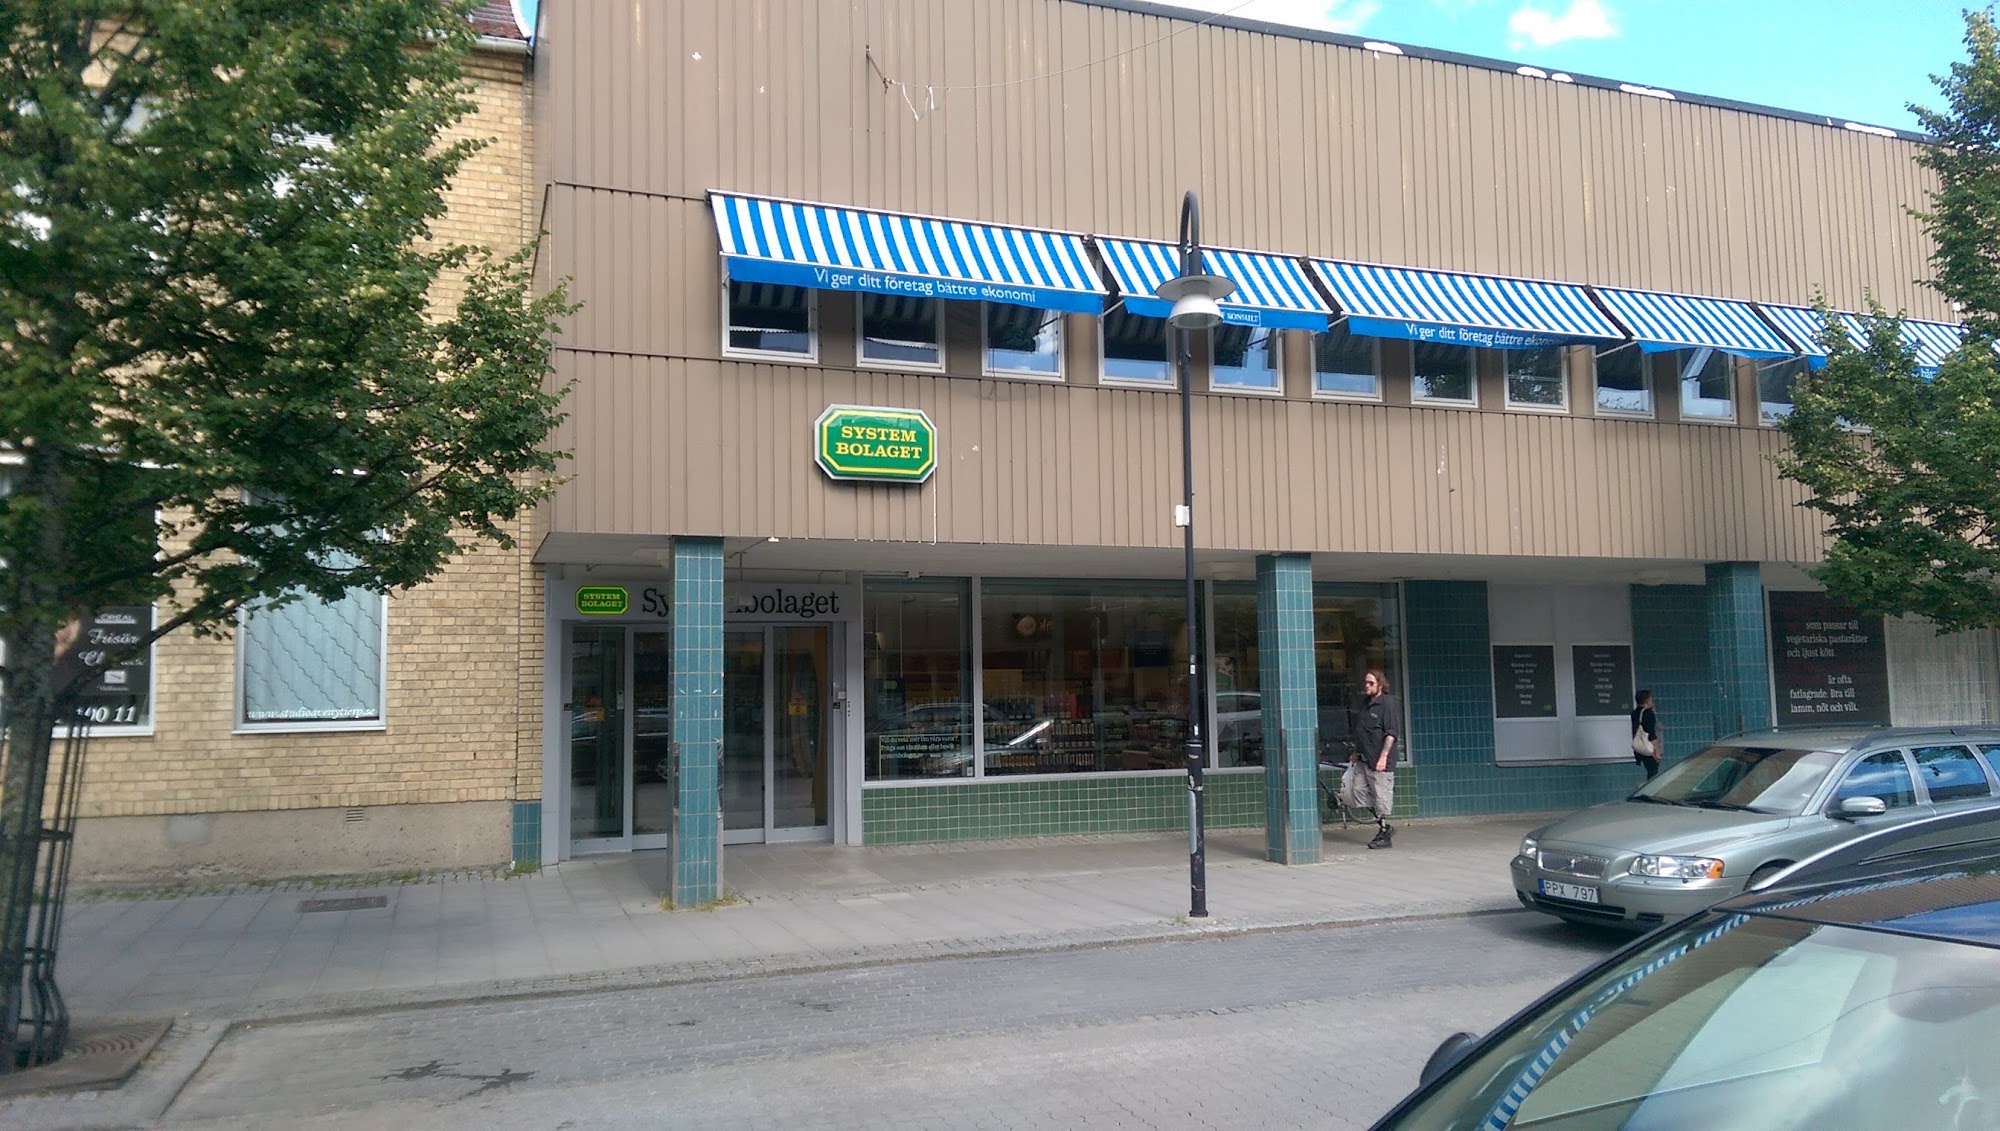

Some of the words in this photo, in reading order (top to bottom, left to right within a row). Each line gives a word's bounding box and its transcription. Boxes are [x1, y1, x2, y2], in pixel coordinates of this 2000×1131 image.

[814, 268, 829, 283] Vi
[832, 273, 854, 289] ger
[859, 273, 881, 289] ditt
[885, 275, 933, 295] företag
[937, 280, 977, 297] bättre
[981, 287, 1036, 303] ekonomi
[1227, 312, 1259, 323] KONSULT
[1405, 322, 1418, 335] Vi
[1420, 328, 1436, 341] ger
[1439, 327, 1456, 340] ditt
[1459, 329, 1493, 347] företag
[1494, 331, 1523, 345] bättre
[841, 425, 917, 442] SYSTEM
[835, 442, 922, 459] BOLAGET
[581, 600, 624, 608] BOLAGET
[1806, 622, 1821, 630] som
[1823, 622, 1847, 632] passar
[1848, 620, 1859, 630] till
[88, 628, 141, 645] Frisör
[1786, 634, 1828, 645] vegetariska
[1829, 634, 1868, 645] pastarätter
[1787, 648, 1801, 657] och
[1802, 648, 1818, 659] ljust
[1828, 675, 1836, 684] är
[1837, 674, 1852, 684] ofta
[1830, 689, 1843, 698] Bra
[1844, 688, 1855, 698] till
[247, 706, 376, 719] www.studioavenytierp.se
[1791, 703, 1815, 713] lamm,
[1816, 702, 1829, 712] nöt
[1830, 702, 1843, 712] och
[1546, 882, 1566, 896] PPX
[1573, 887, 1595, 901] 797
